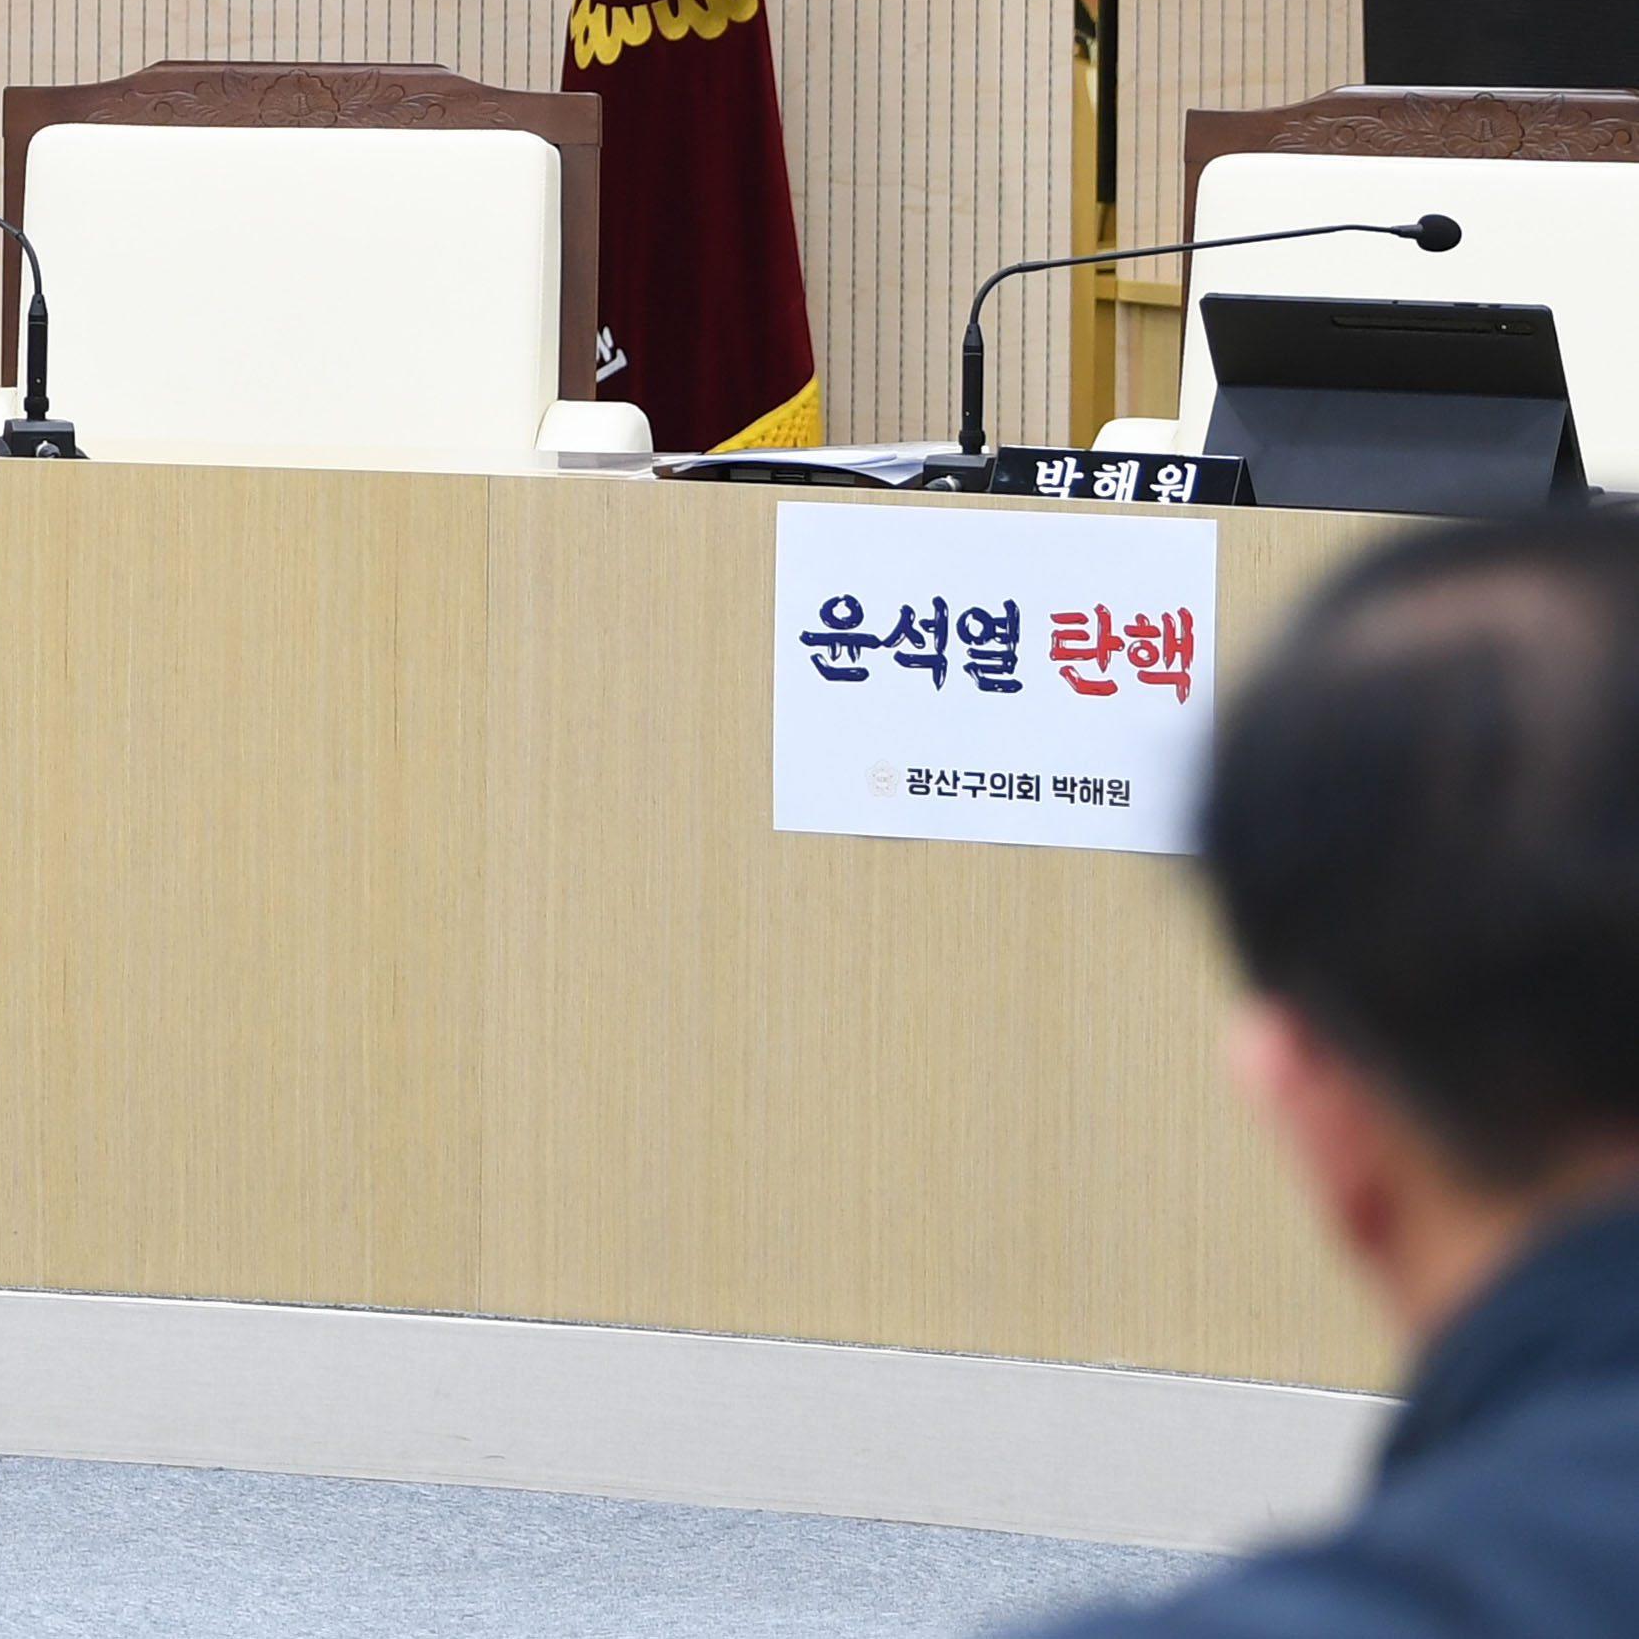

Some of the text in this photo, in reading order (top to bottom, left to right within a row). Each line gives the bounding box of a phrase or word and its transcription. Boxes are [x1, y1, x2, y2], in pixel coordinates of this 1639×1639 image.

[798, 593, 1195, 705] 윤석열 탄핵
[905, 766, 1132, 808] 광산구의회 박해원
